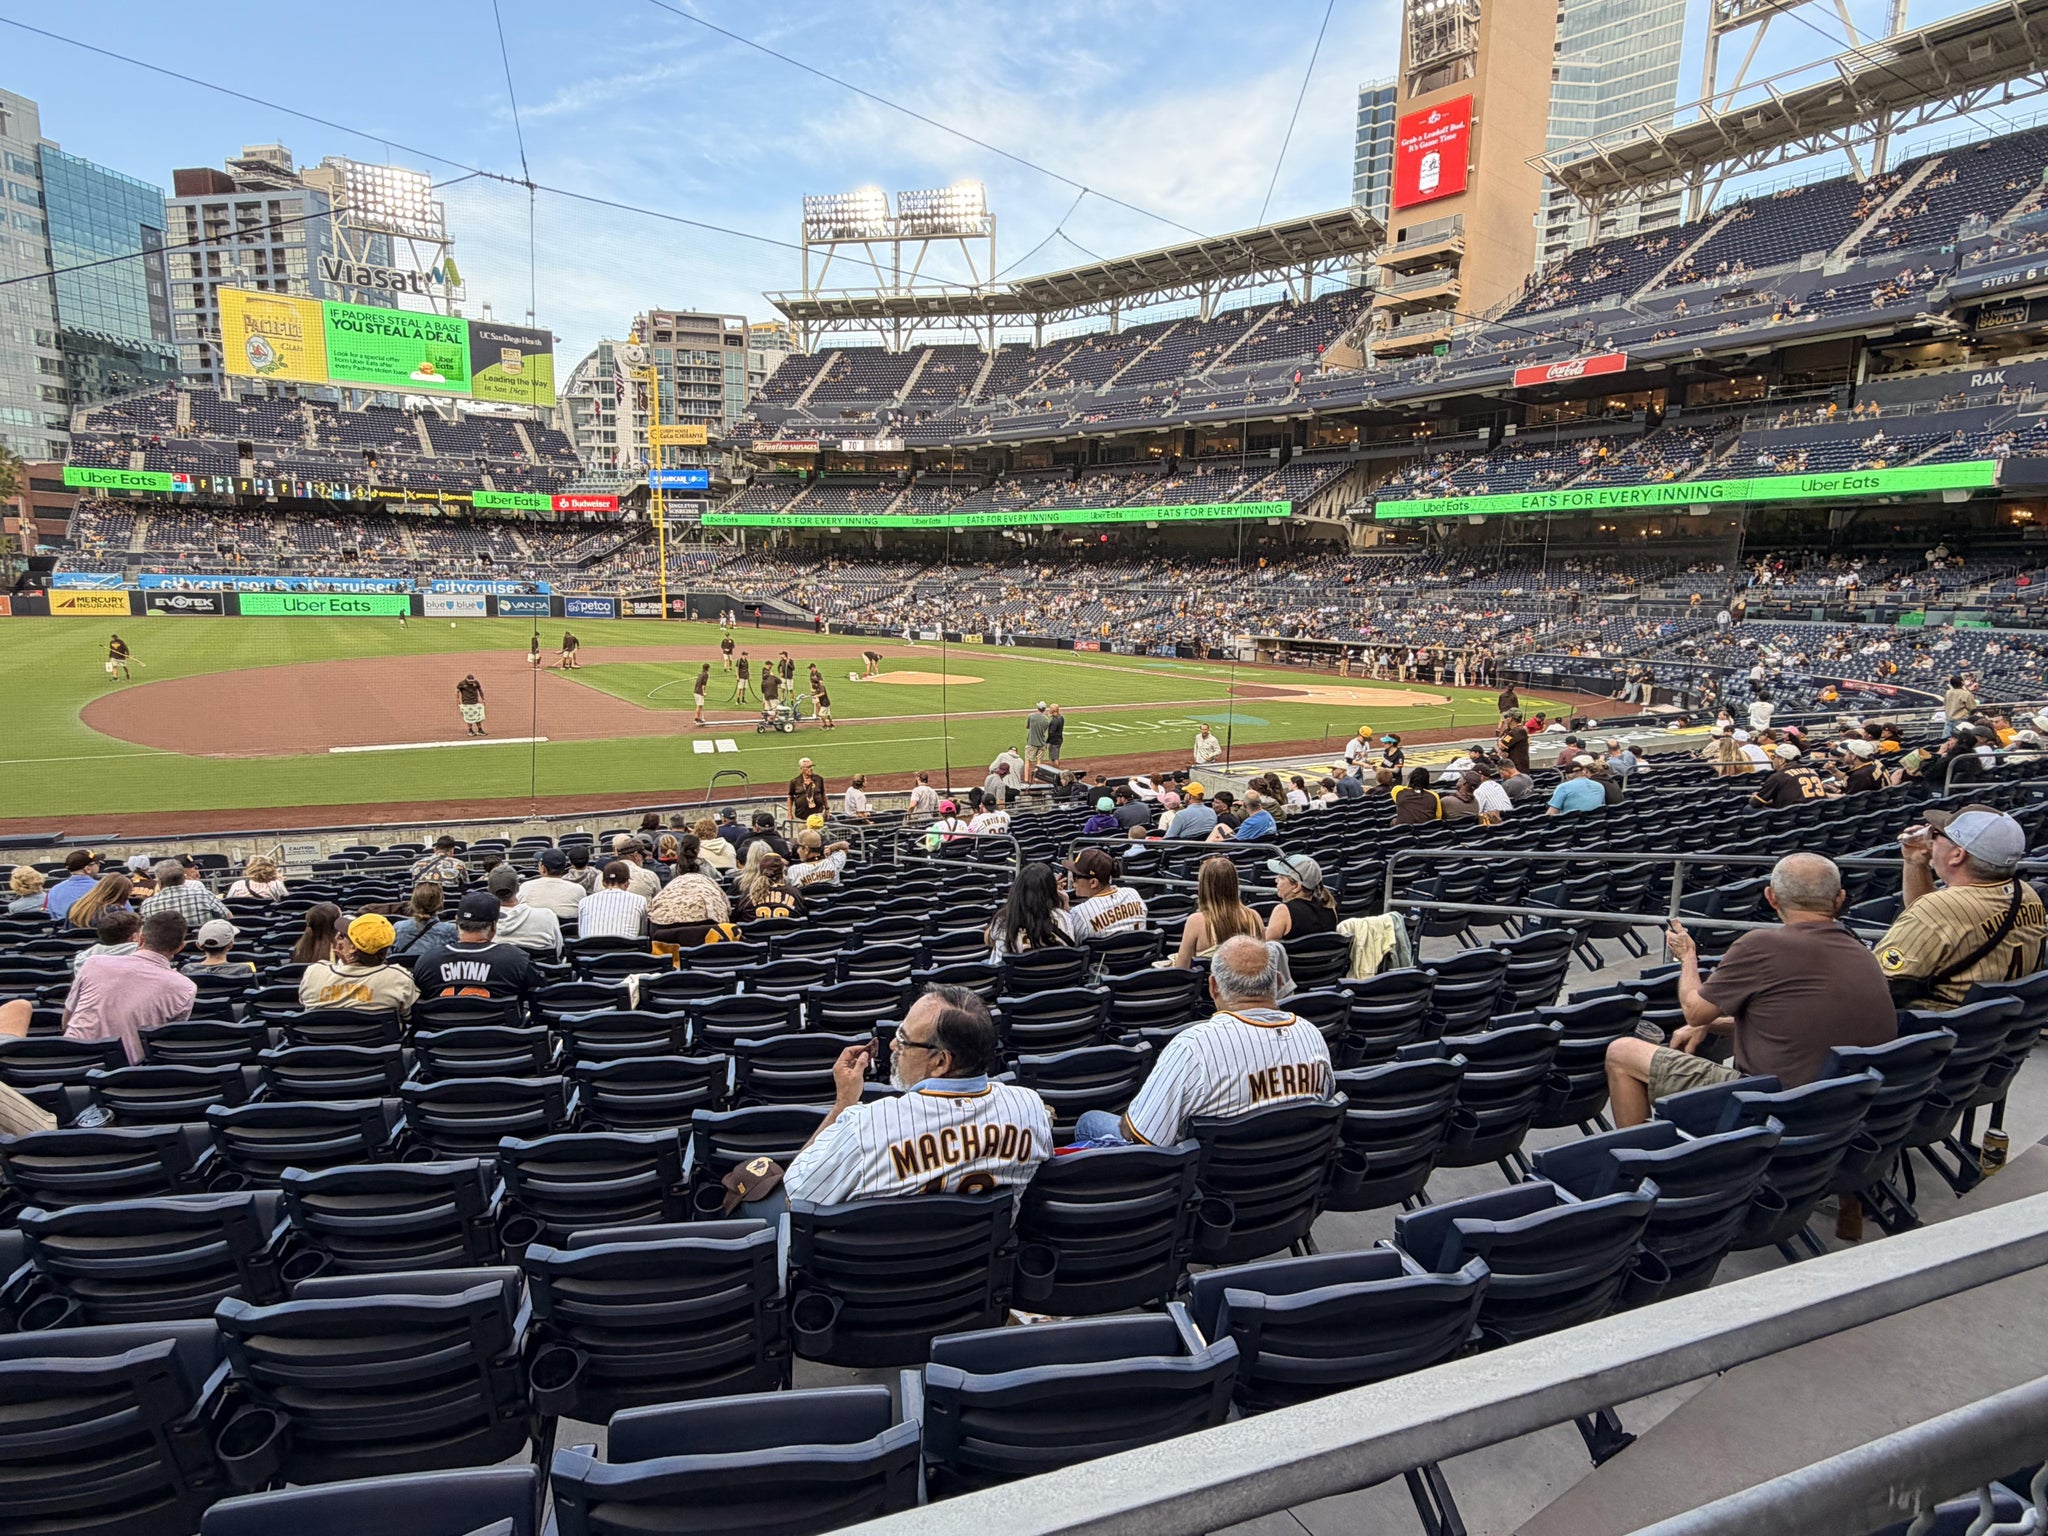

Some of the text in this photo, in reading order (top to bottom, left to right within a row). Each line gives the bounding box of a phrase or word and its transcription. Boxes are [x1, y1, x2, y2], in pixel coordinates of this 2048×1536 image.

[1440, 133, 1457, 143] Time
[323, 256, 423, 294] Viasat
[1981, 272, 2021, 289] STEVE
[2026, 268, 2037, 280] 6
[330, 308, 462, 334] IF PADRES STEAL A BASE
[331, 318, 463, 345] YOU STEAL A DEAL
[434, 355, 454, 364] Uber
[435, 362, 455, 371] Eats
[483, 374, 548, 389] Leading the Way
[1970, 370, 2007, 388] RAK
[509, 387, 529, 395] Diego
[80, 471, 118, 484] Uber
[120, 473, 157, 487] Eats
[200, 479, 207, 489] F
[1801, 476, 1880, 493] Uber Eats
[241, 481, 248, 491] F
[281, 483, 288, 493] F
[485, 494, 541, 507] Uber Eats
[571, 498, 611, 508] Budweiser
[1521, 485, 1724, 509] EATS FOR EVERY INNING
[1157, 504, 1283, 518] EATS FOR EVERY INNING
[1423, 500, 1470, 513] Uber Eats
[770, 516, 879, 525] EATS FOR EVERY INNING
[912, 517, 942, 525] Uber Eats
[966, 512, 1060, 524] EATS FOR EVERY INNING
[1090, 511, 1123, 519] Uber Eats
[76, 596, 124, 604] MERCURY
[283, 598, 371, 612] Uber Eats
[426, 601, 475, 609] blue blue
[581, 600, 611, 613] petco
[1798, 776, 1825, 798] 23
[800, 870, 836, 887] MACHADO
[440, 961, 491, 982] GWYNN
[889, 1123, 1033, 1181] MACHADO
